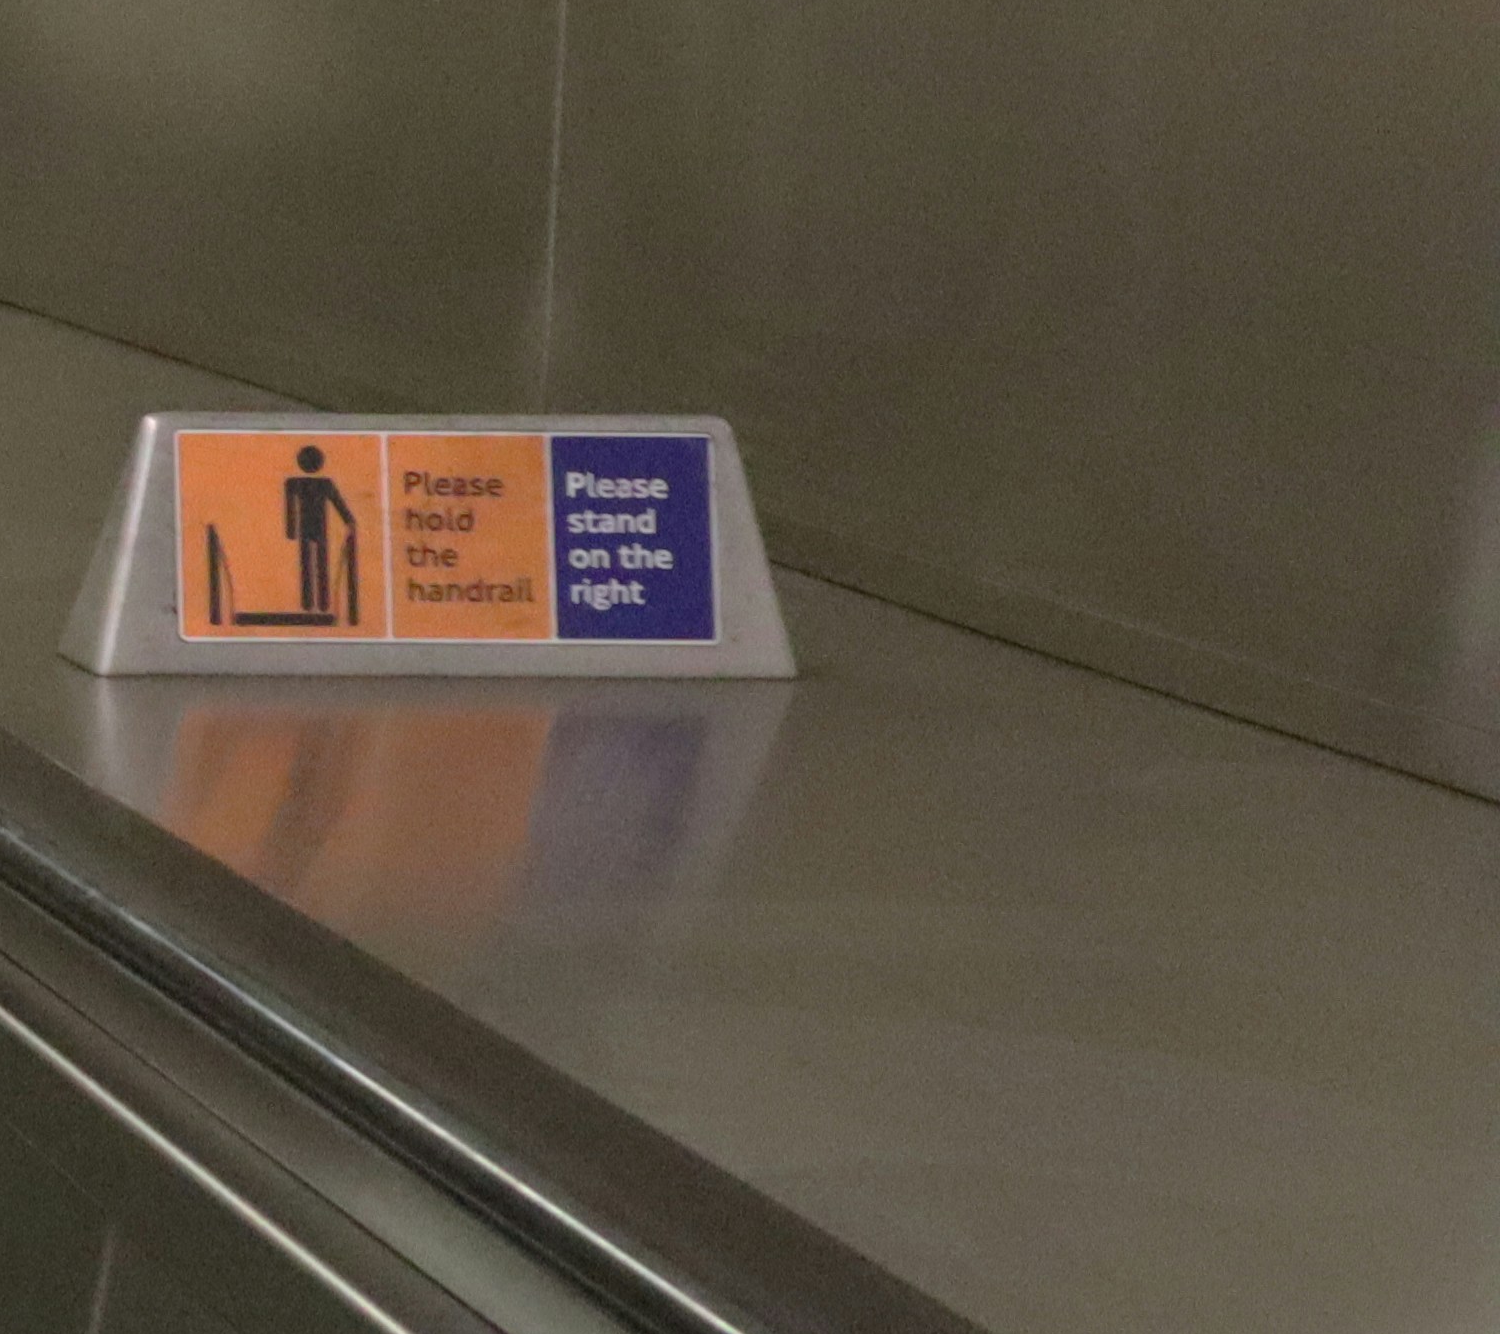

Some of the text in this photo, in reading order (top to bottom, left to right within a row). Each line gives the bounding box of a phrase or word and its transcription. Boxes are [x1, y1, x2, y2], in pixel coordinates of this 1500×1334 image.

[403, 471, 505, 499] Please
[564, 471, 669, 500] Please
[405, 507, 475, 533] hold
[566, 507, 657, 535] stand
[406, 542, 459, 568] the
[568, 542, 675, 571] on the
[406, 577, 536, 604] handrail
[569, 578, 646, 612] right
